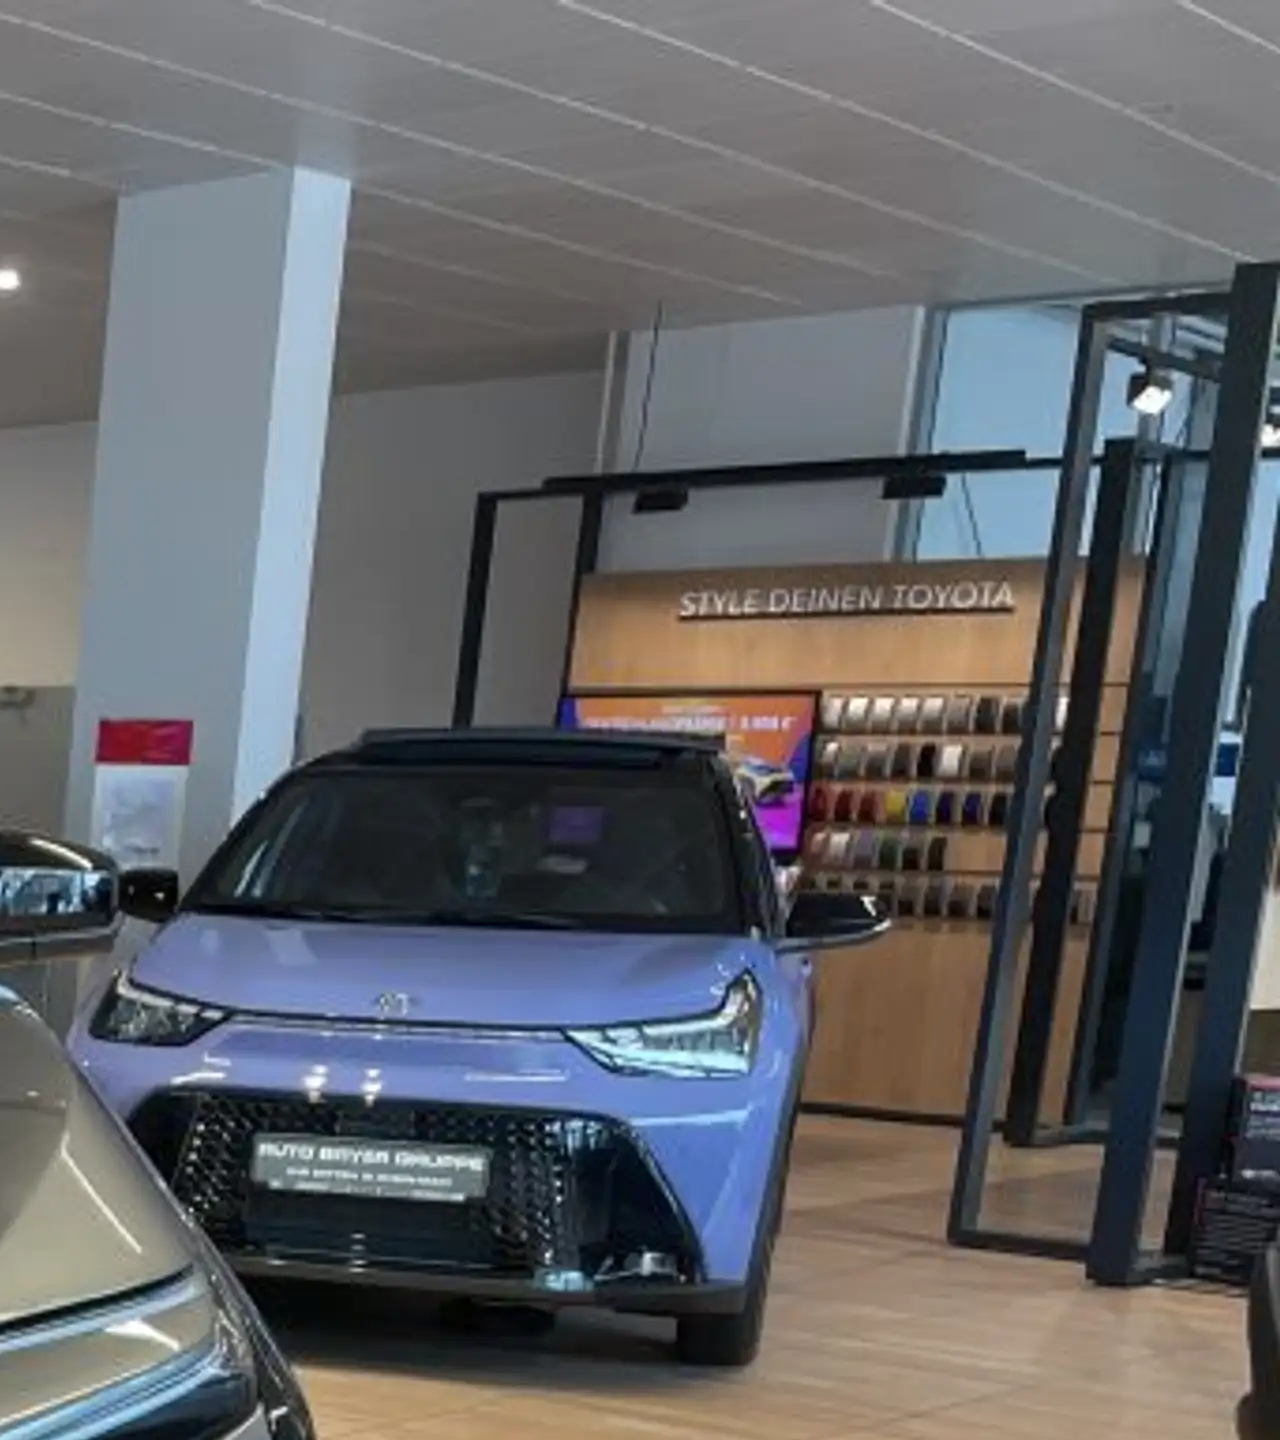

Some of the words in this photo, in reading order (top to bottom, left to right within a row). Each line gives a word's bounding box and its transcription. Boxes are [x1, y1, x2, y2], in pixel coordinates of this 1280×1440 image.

[679, 590, 760, 618] STYLE
[768, 586, 884, 613] DEINEN
[892, 580, 1016, 609] TOYOTA
